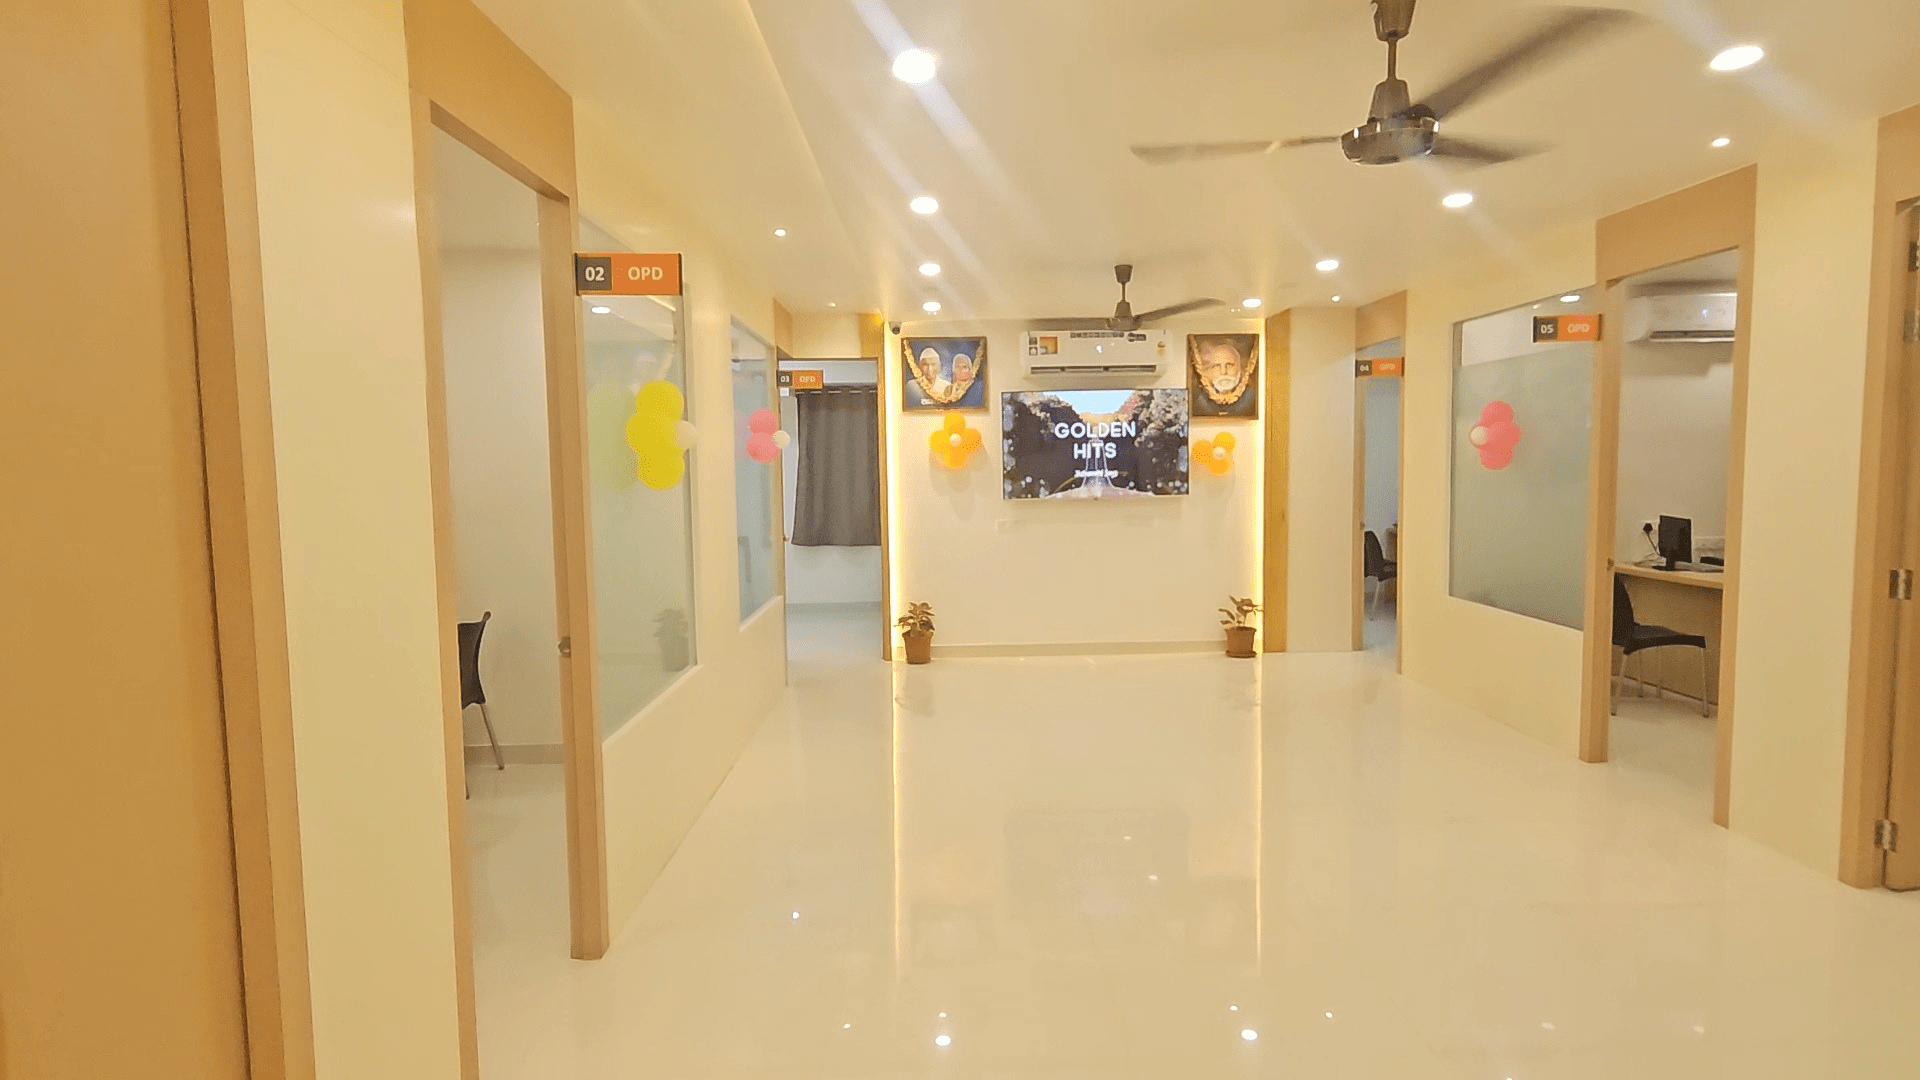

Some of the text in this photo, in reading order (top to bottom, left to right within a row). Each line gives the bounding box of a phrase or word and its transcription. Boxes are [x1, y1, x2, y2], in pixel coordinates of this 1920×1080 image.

[585, 266, 663, 281] 02 OPD
[1540, 324, 1554, 334] 05
[1054, 421, 1136, 439] GOLDEN
[1073, 442, 1117, 459] HITS
